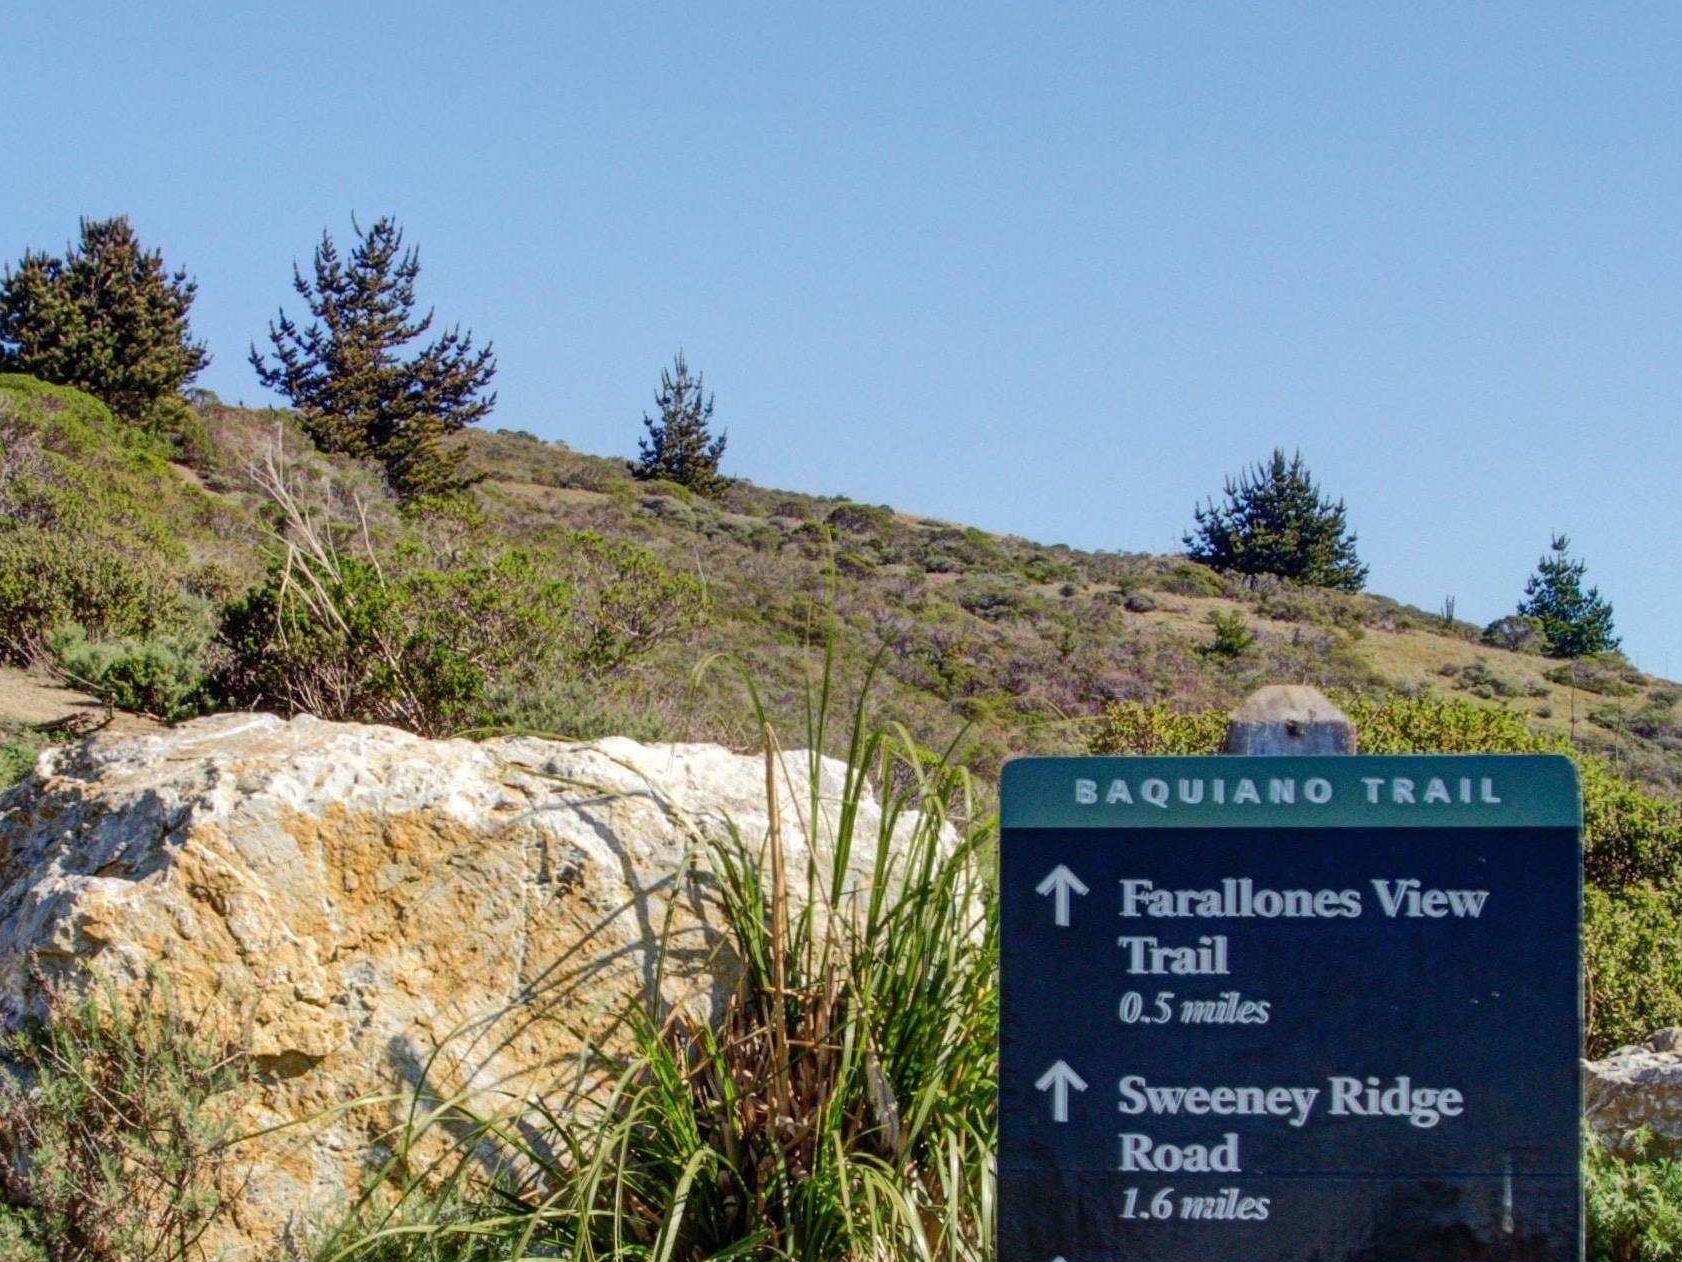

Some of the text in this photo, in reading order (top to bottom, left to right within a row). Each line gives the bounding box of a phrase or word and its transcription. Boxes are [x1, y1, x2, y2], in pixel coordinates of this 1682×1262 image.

[1075, 777, 1502, 806] BAQUIANO TRAIL
[1119, 877, 1490, 918] Farallones View
[1117, 934, 1231, 976] Trail
[1119, 990, 1272, 1025] 0.5 miles
[1118, 1075, 1464, 1127] Sweeney Ridge
[1118, 1132, 1242, 1173] Road
[1120, 1187, 1271, 1221] 1.6 miles
